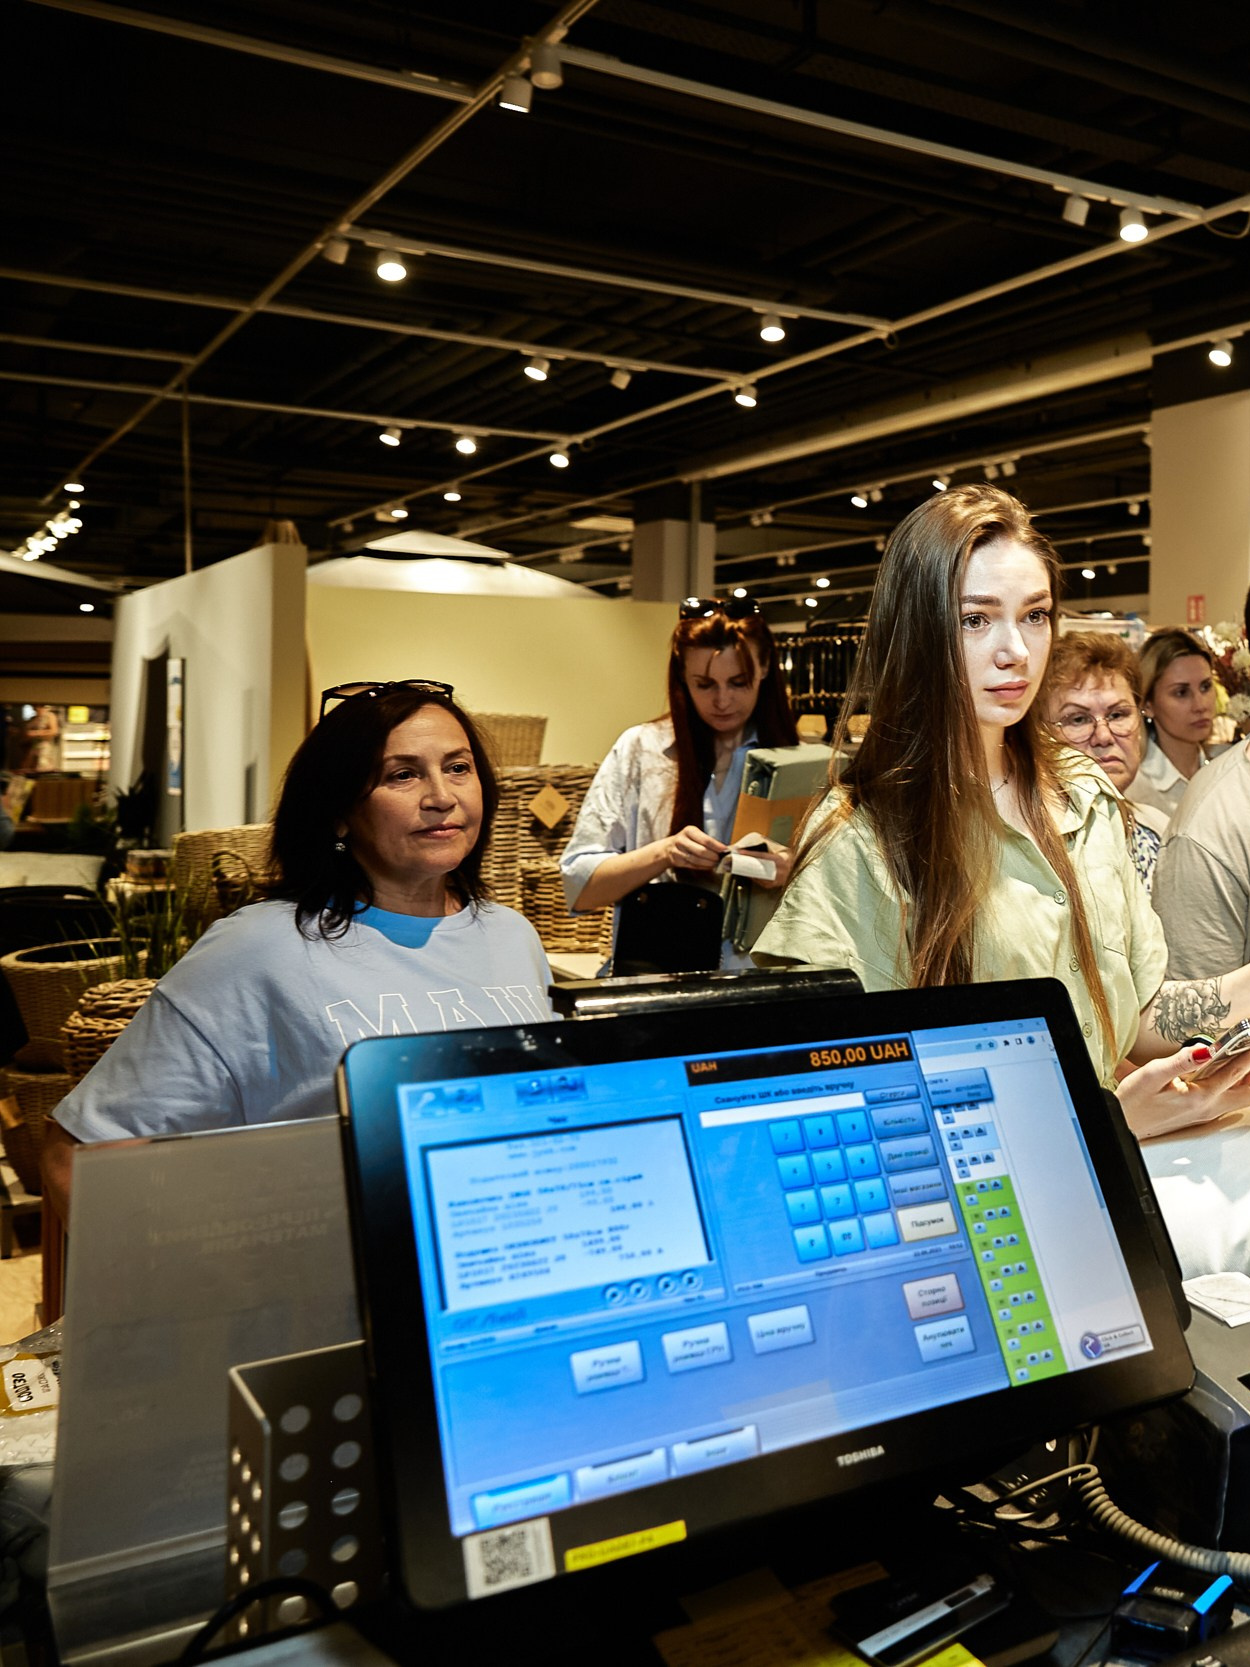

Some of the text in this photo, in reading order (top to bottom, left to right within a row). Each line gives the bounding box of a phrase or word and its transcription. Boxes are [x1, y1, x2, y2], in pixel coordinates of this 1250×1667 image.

[691, 1041, 910, 1074] UAH 850,00 UAH
[714, 1093, 756, 1104] Скануйте
[774, 1088, 790, 1097] або
[911, 1216, 944, 1228] Підсумок
[918, 1286, 946, 1297] Сторно
[837, 1444, 885, 1468] TOSHIBA
